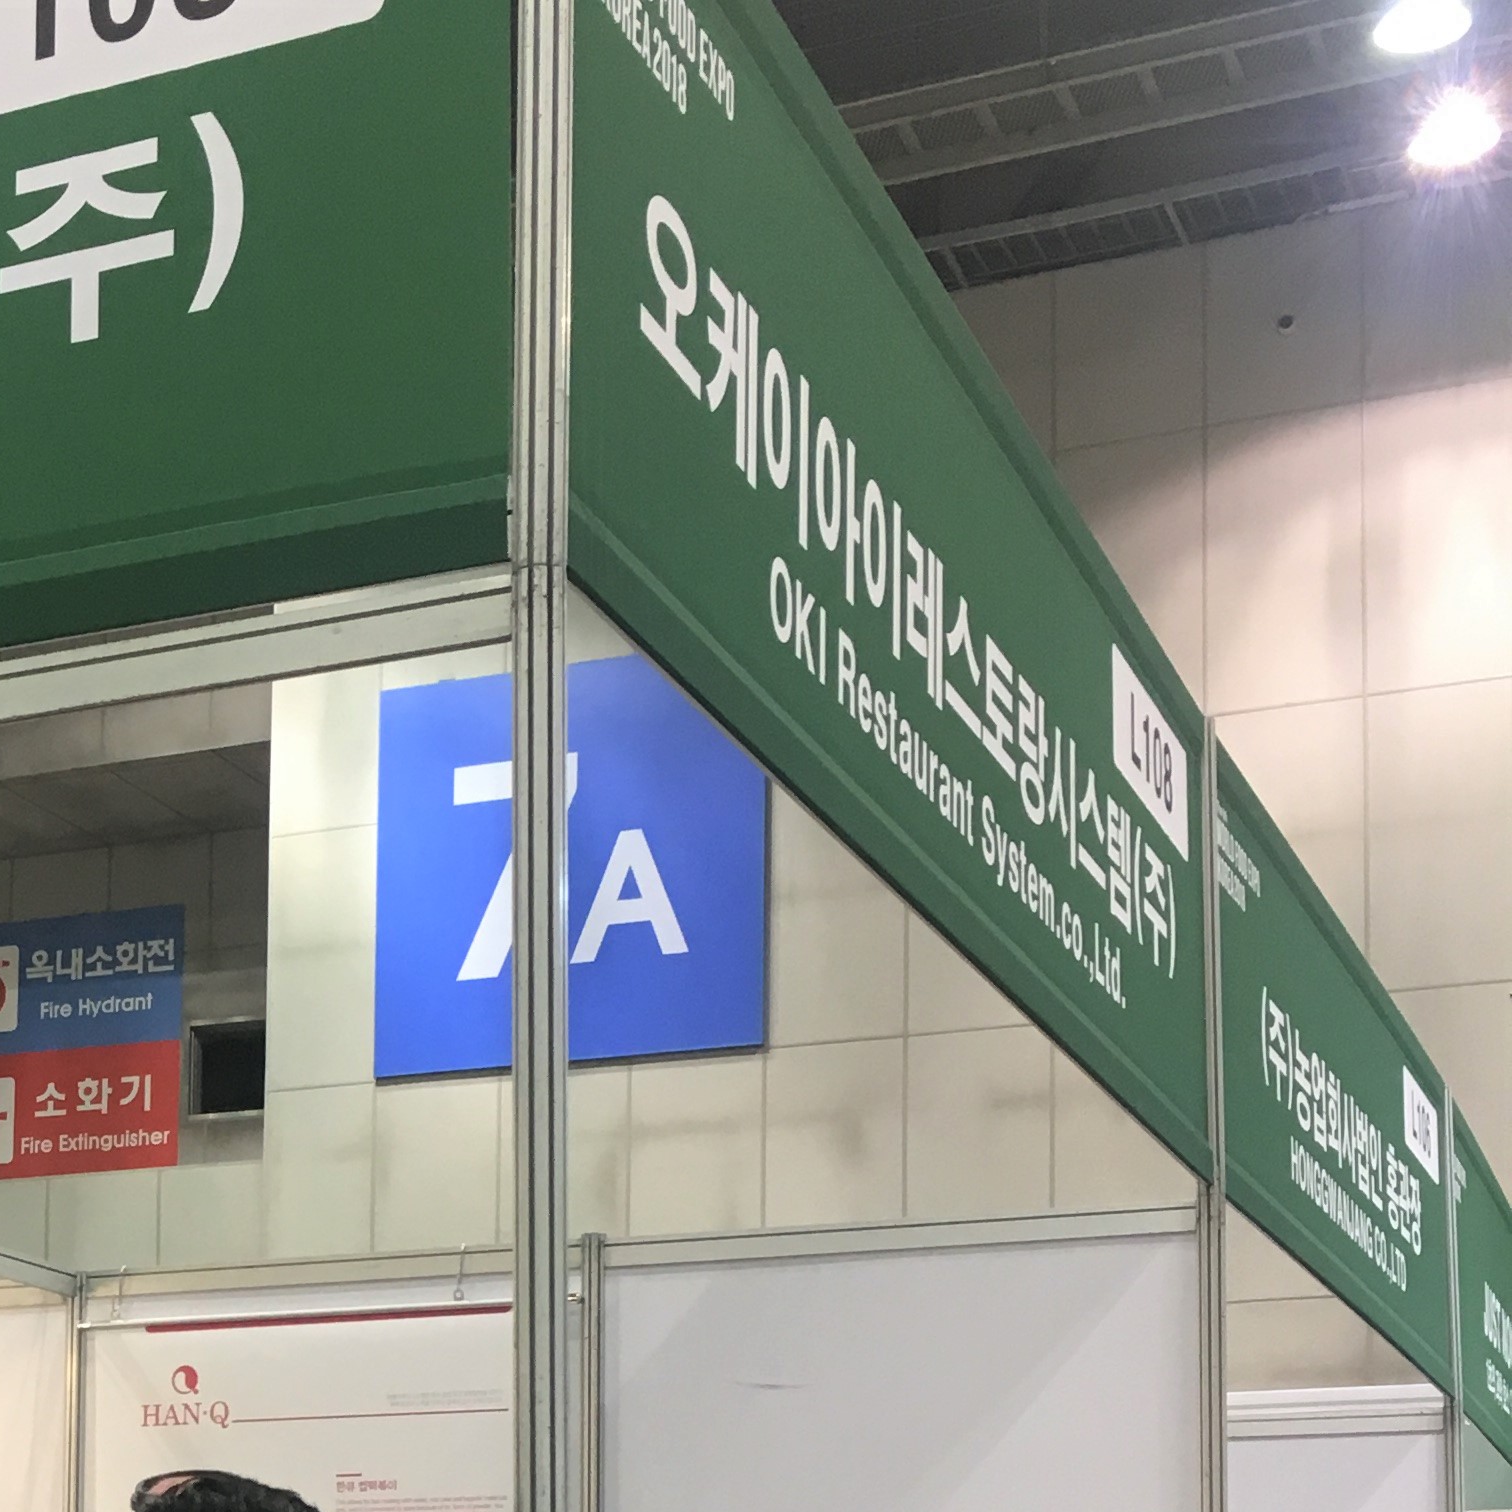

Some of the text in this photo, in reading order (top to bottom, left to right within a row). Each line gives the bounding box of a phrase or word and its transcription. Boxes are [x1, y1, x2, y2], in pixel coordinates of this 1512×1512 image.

[653, 27, 686, 114] 2018
[699, 28, 734, 121] EXPO
[640, 195, 1176, 979] 오케이아이레스토랑시스템(주)
[770, 556, 826, 685] OKI
[838, 628, 974, 846] Restaurant
[1131, 691, 1173, 813] L108
[26, 938, 175, 983] 옥내소화전
[40, 992, 153, 1019] Fire Hydrant
[21, 1128, 170, 1154] Fire Extinguisher
